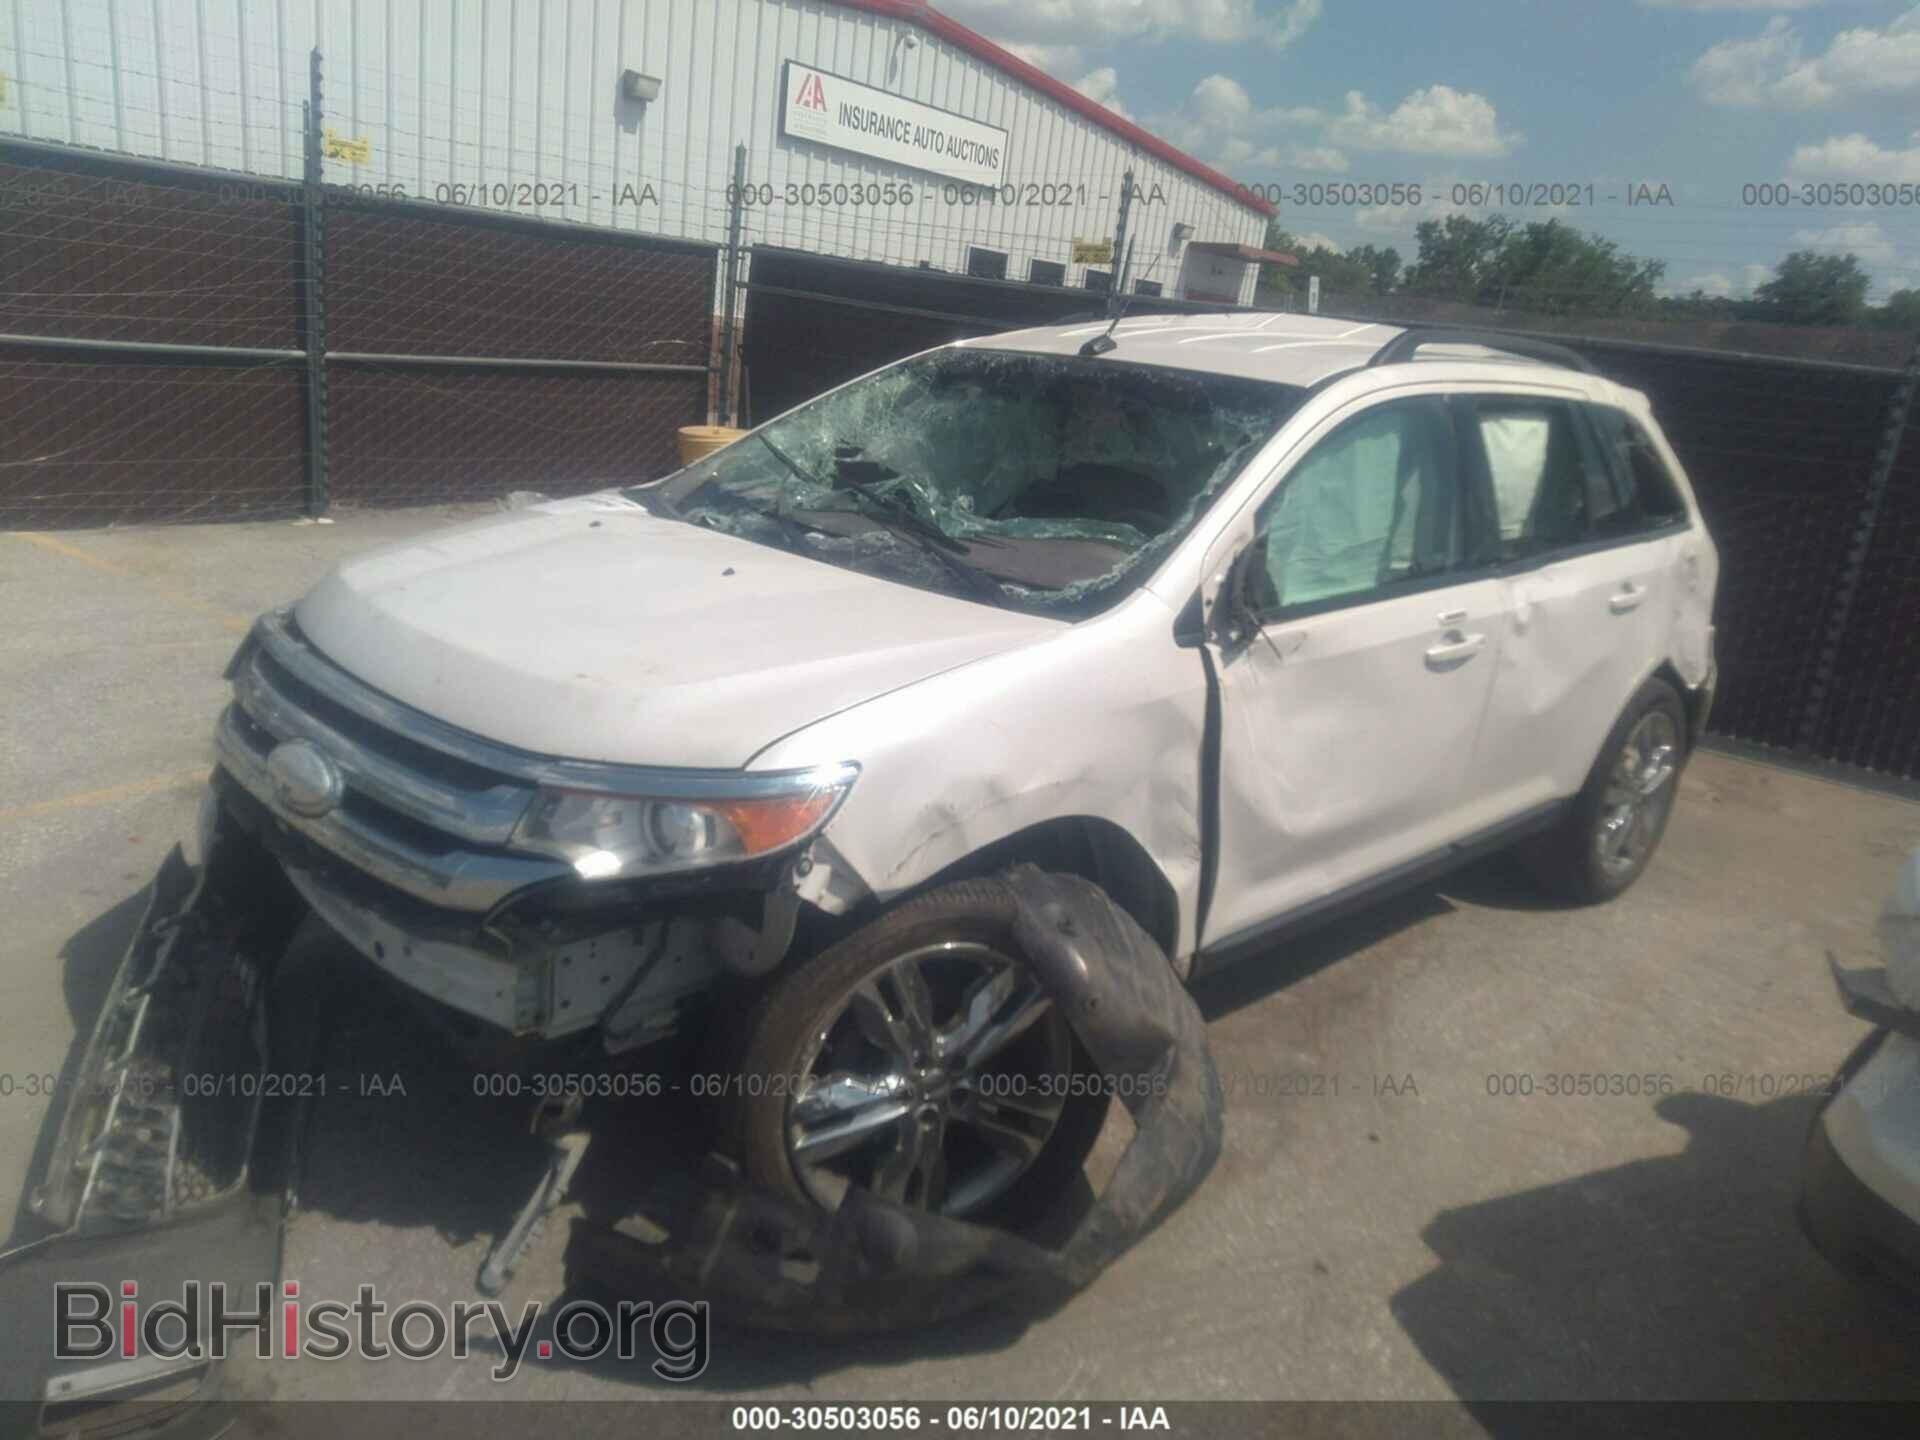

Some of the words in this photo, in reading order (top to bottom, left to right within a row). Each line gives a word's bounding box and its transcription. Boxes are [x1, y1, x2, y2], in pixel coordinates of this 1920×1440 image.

[838, 101, 911, 145] INSURANCE
[912, 126, 945, 154] AUTO
[946, 136, 1000, 170] AUCTIONS
